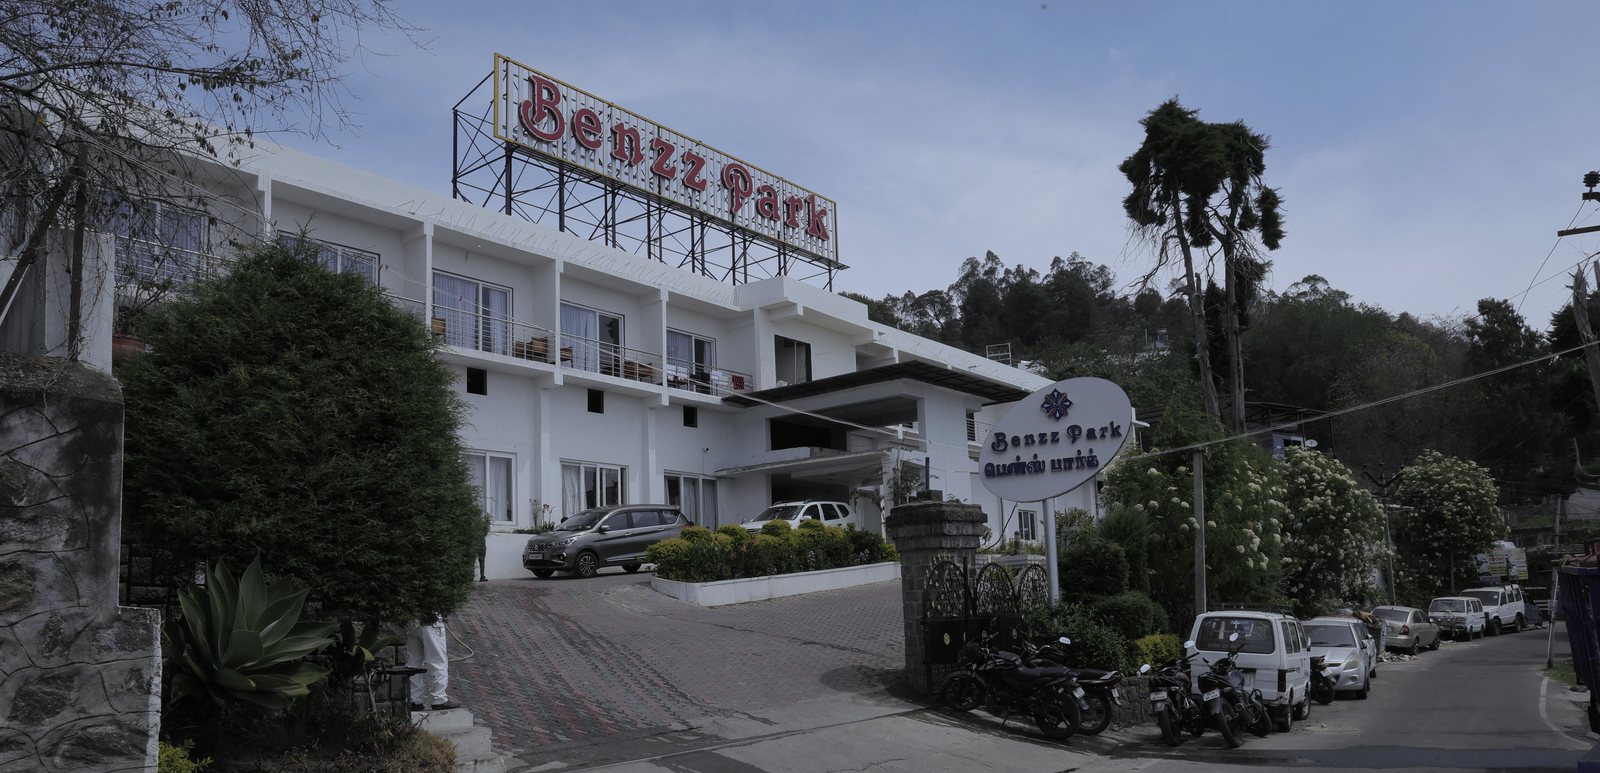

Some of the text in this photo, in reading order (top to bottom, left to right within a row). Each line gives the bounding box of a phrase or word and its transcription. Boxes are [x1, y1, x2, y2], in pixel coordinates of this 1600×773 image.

[518, 74, 830, 241] Benzz Park
[991, 420, 1122, 454] Benzz Park
[984, 448, 1099, 478] பென்ஸ் பார்க்
